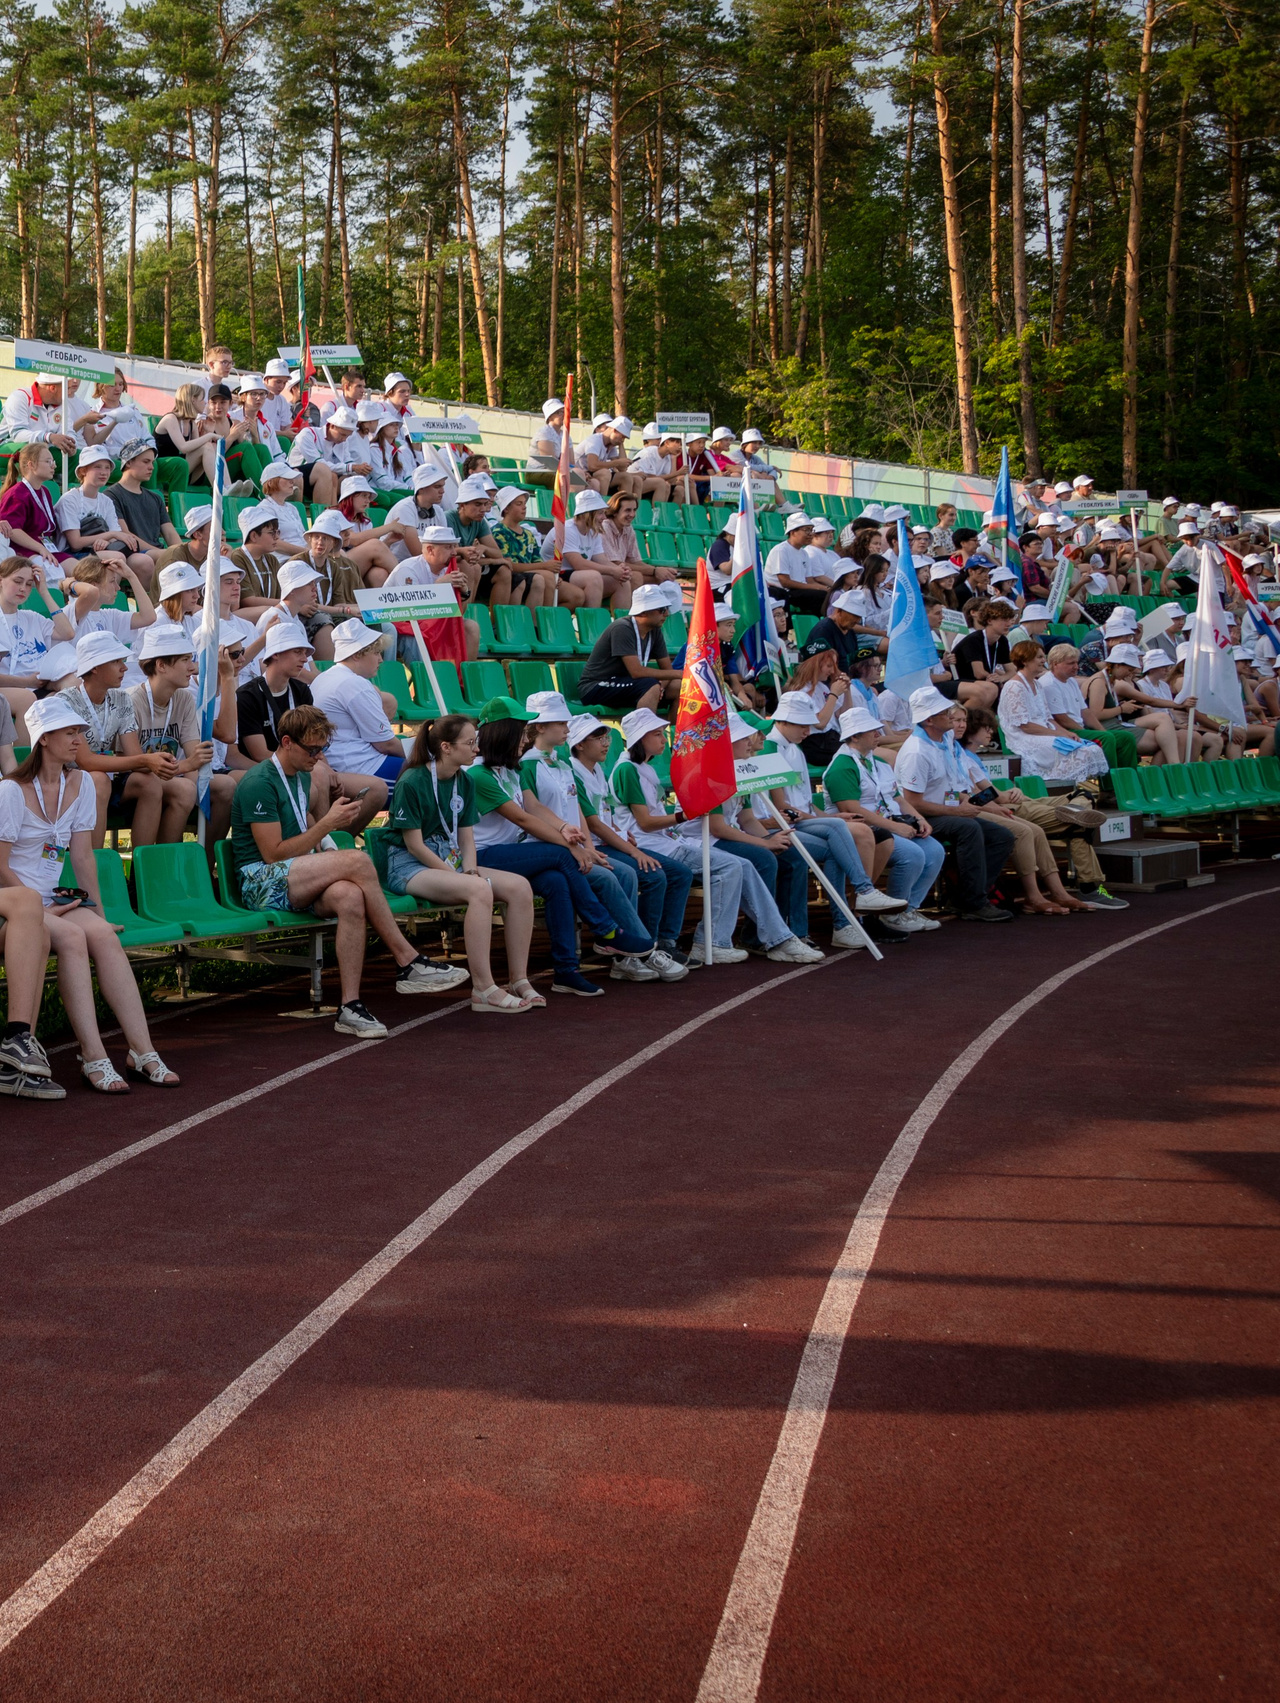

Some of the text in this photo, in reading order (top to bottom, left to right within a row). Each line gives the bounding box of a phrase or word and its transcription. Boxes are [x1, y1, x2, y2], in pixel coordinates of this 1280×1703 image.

[45, 350, 87, 364] «ГЕОБАРС»
[31, 361, 100, 379] Республика Татарстан
[378, 590, 436, 603] «УФА-КОНТАКТ»
[371, 606, 453, 620] Республика Башкортостан
[1112, 822, 1125, 833] РЯД
